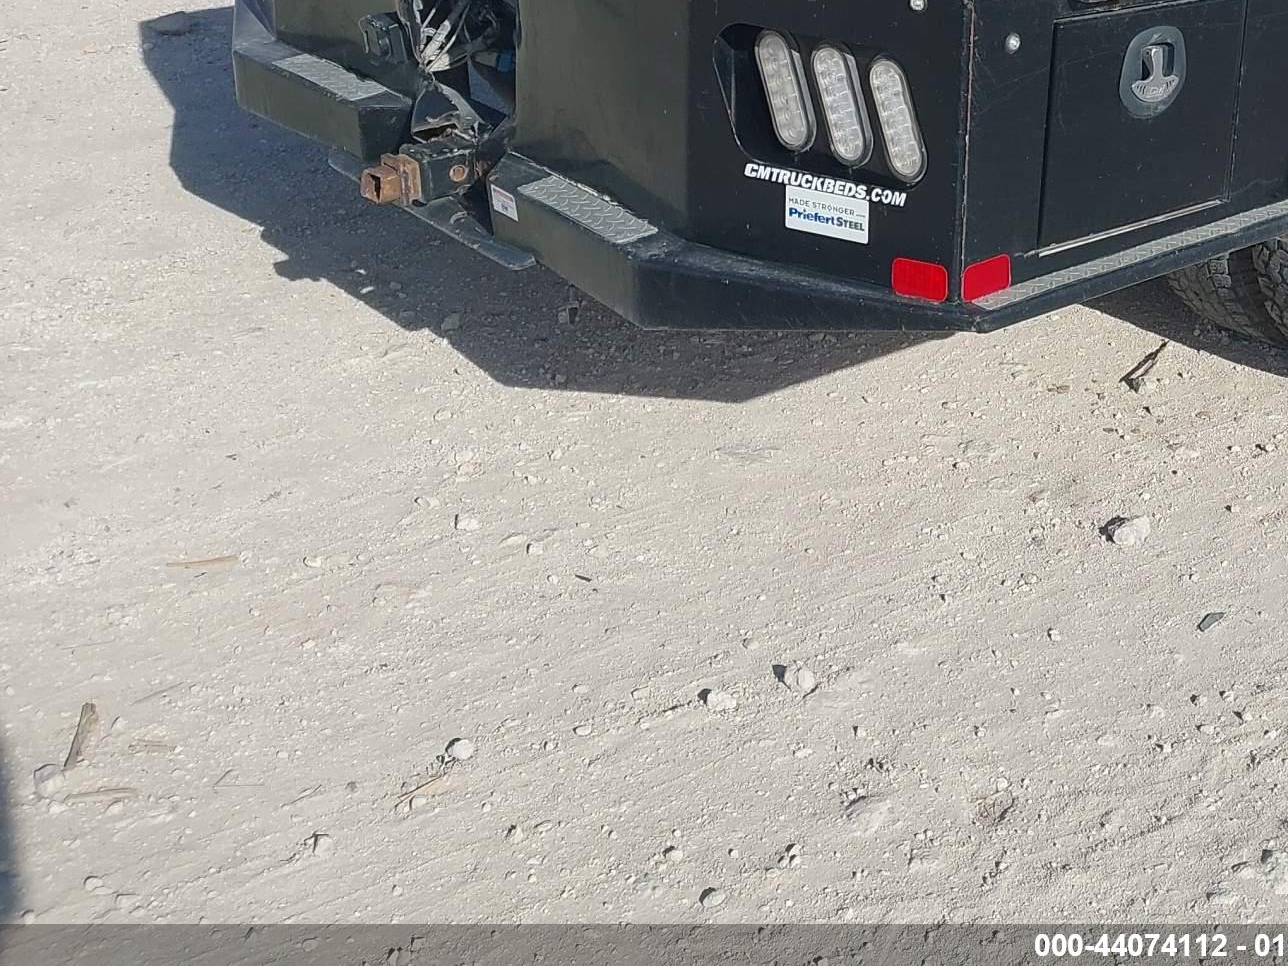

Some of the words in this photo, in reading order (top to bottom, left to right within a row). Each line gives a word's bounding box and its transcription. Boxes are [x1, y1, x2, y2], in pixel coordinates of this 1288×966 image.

[744, 163, 907, 207] CMTRUCKBEDS.COM
[788, 197, 810, 208] MADE
[812, 201, 855, 217] STRONGER
